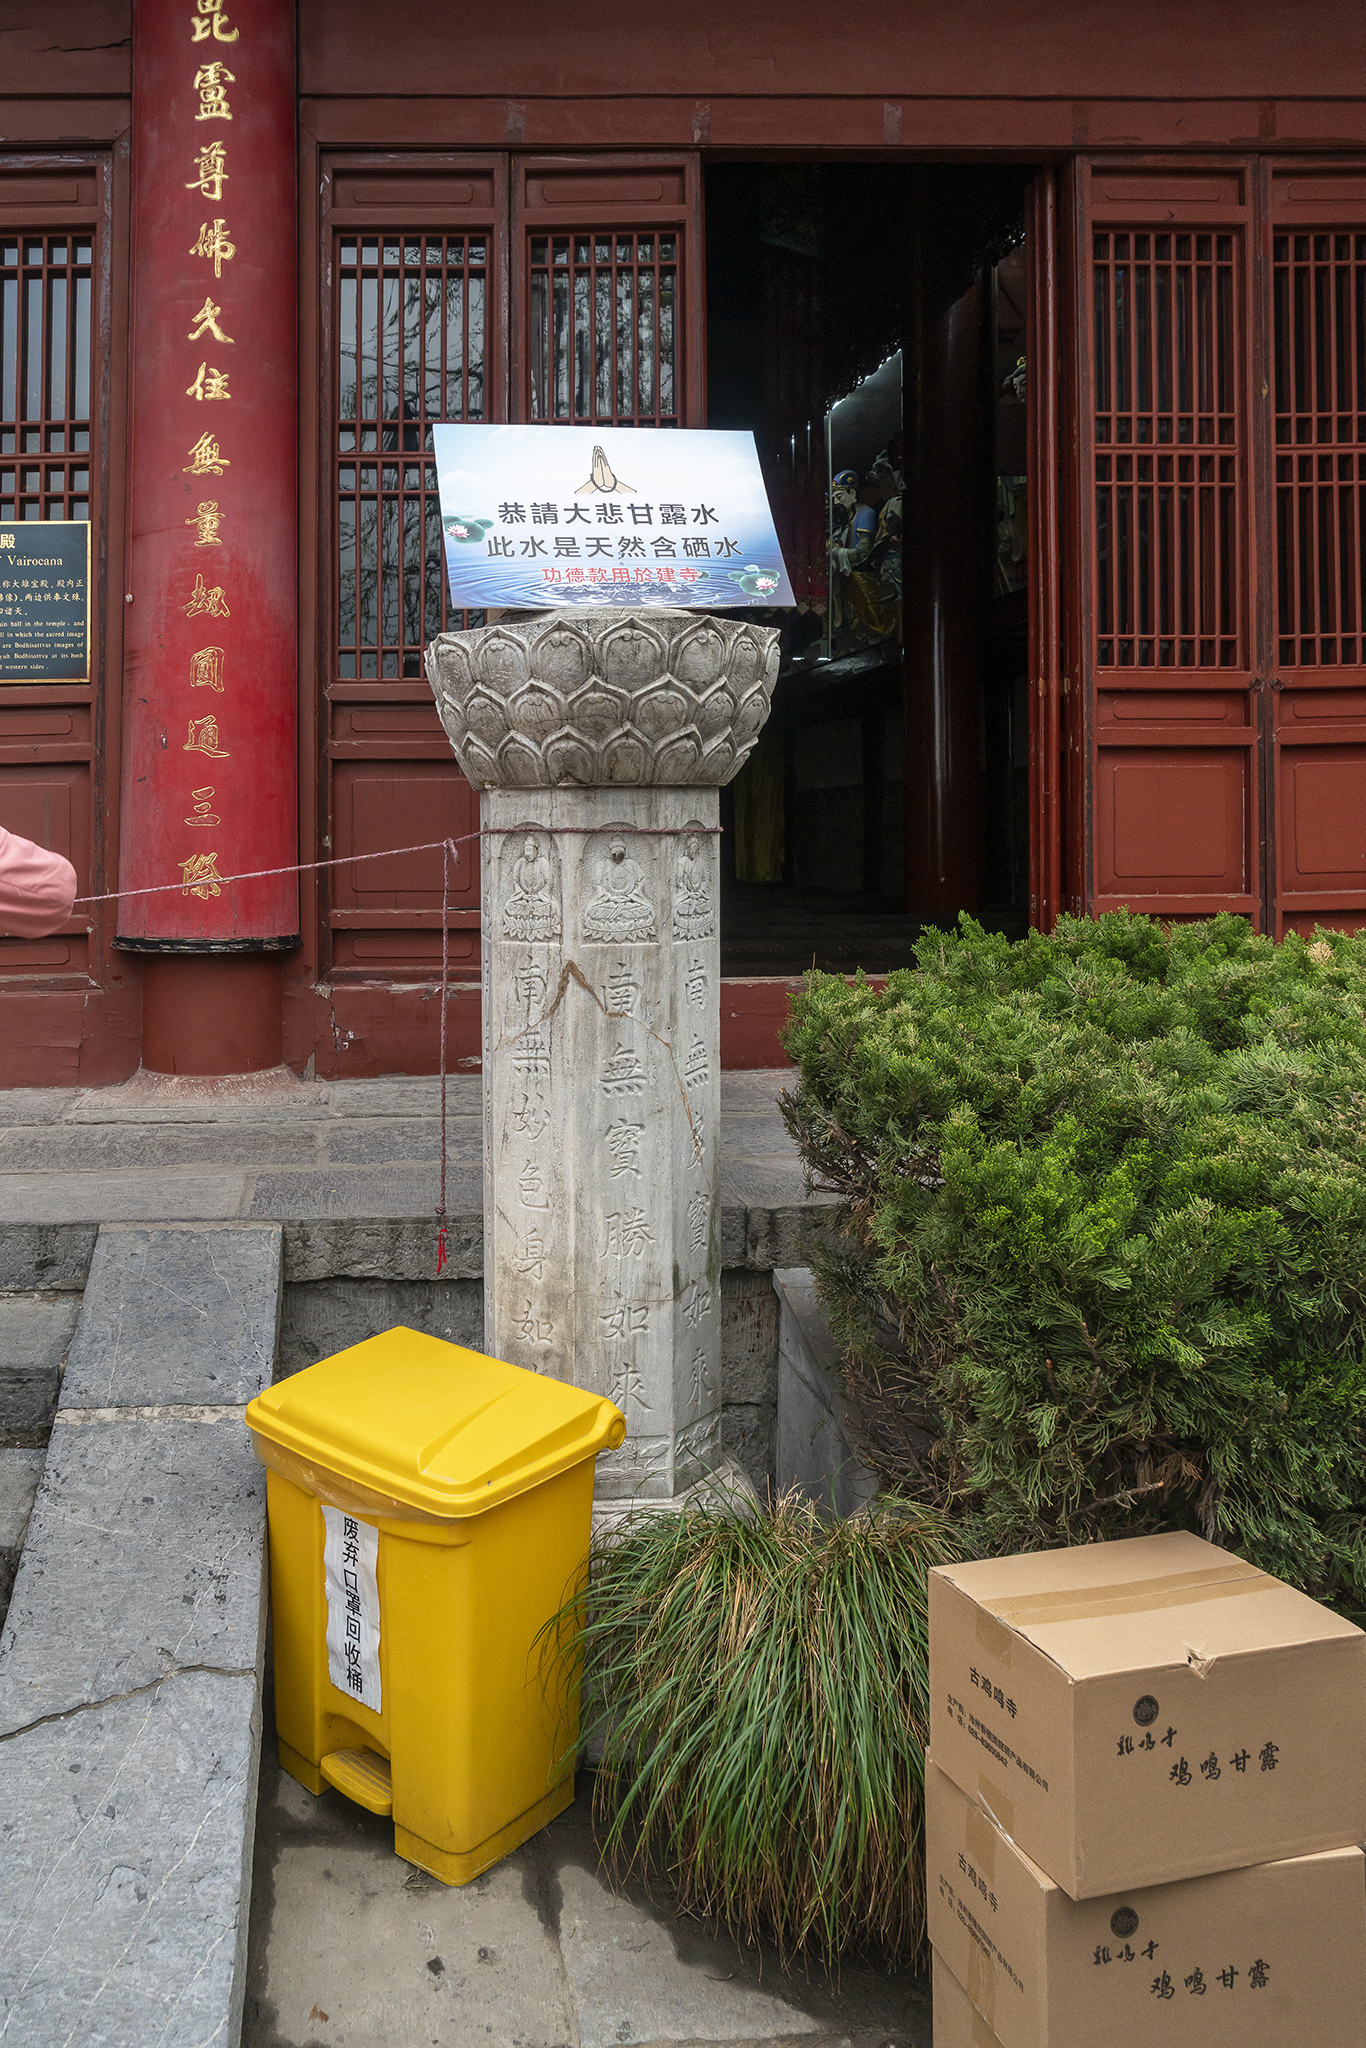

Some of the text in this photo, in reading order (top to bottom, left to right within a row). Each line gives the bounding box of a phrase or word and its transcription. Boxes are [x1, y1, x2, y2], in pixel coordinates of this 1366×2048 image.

[498, 502, 720, 526] 恭請大悲甘露水
[7, 555, 63, 566] Vairocana
[487, 536, 744, 559] 此水是天然含硒水
[541, 567, 699, 583] 功德款用於建寺
[54, 642, 75, 650] images
[66, 631, 84, 639] image
[511, 954, 554, 1375] 南無妙色身如
[600, 961, 658, 1414] 南無寶勝如來
[342, 1516, 363, 1694] 废弃口罩回收桶
[969, 1667, 1018, 1719] 古鸡鸣寺
[1169, 1741, 1279, 1786] 鸡鸣甘露
[958, 1852, 998, 1913] 古鸡鸣寺
[1150, 1959, 1270, 1999] 鸡鸣甘露
